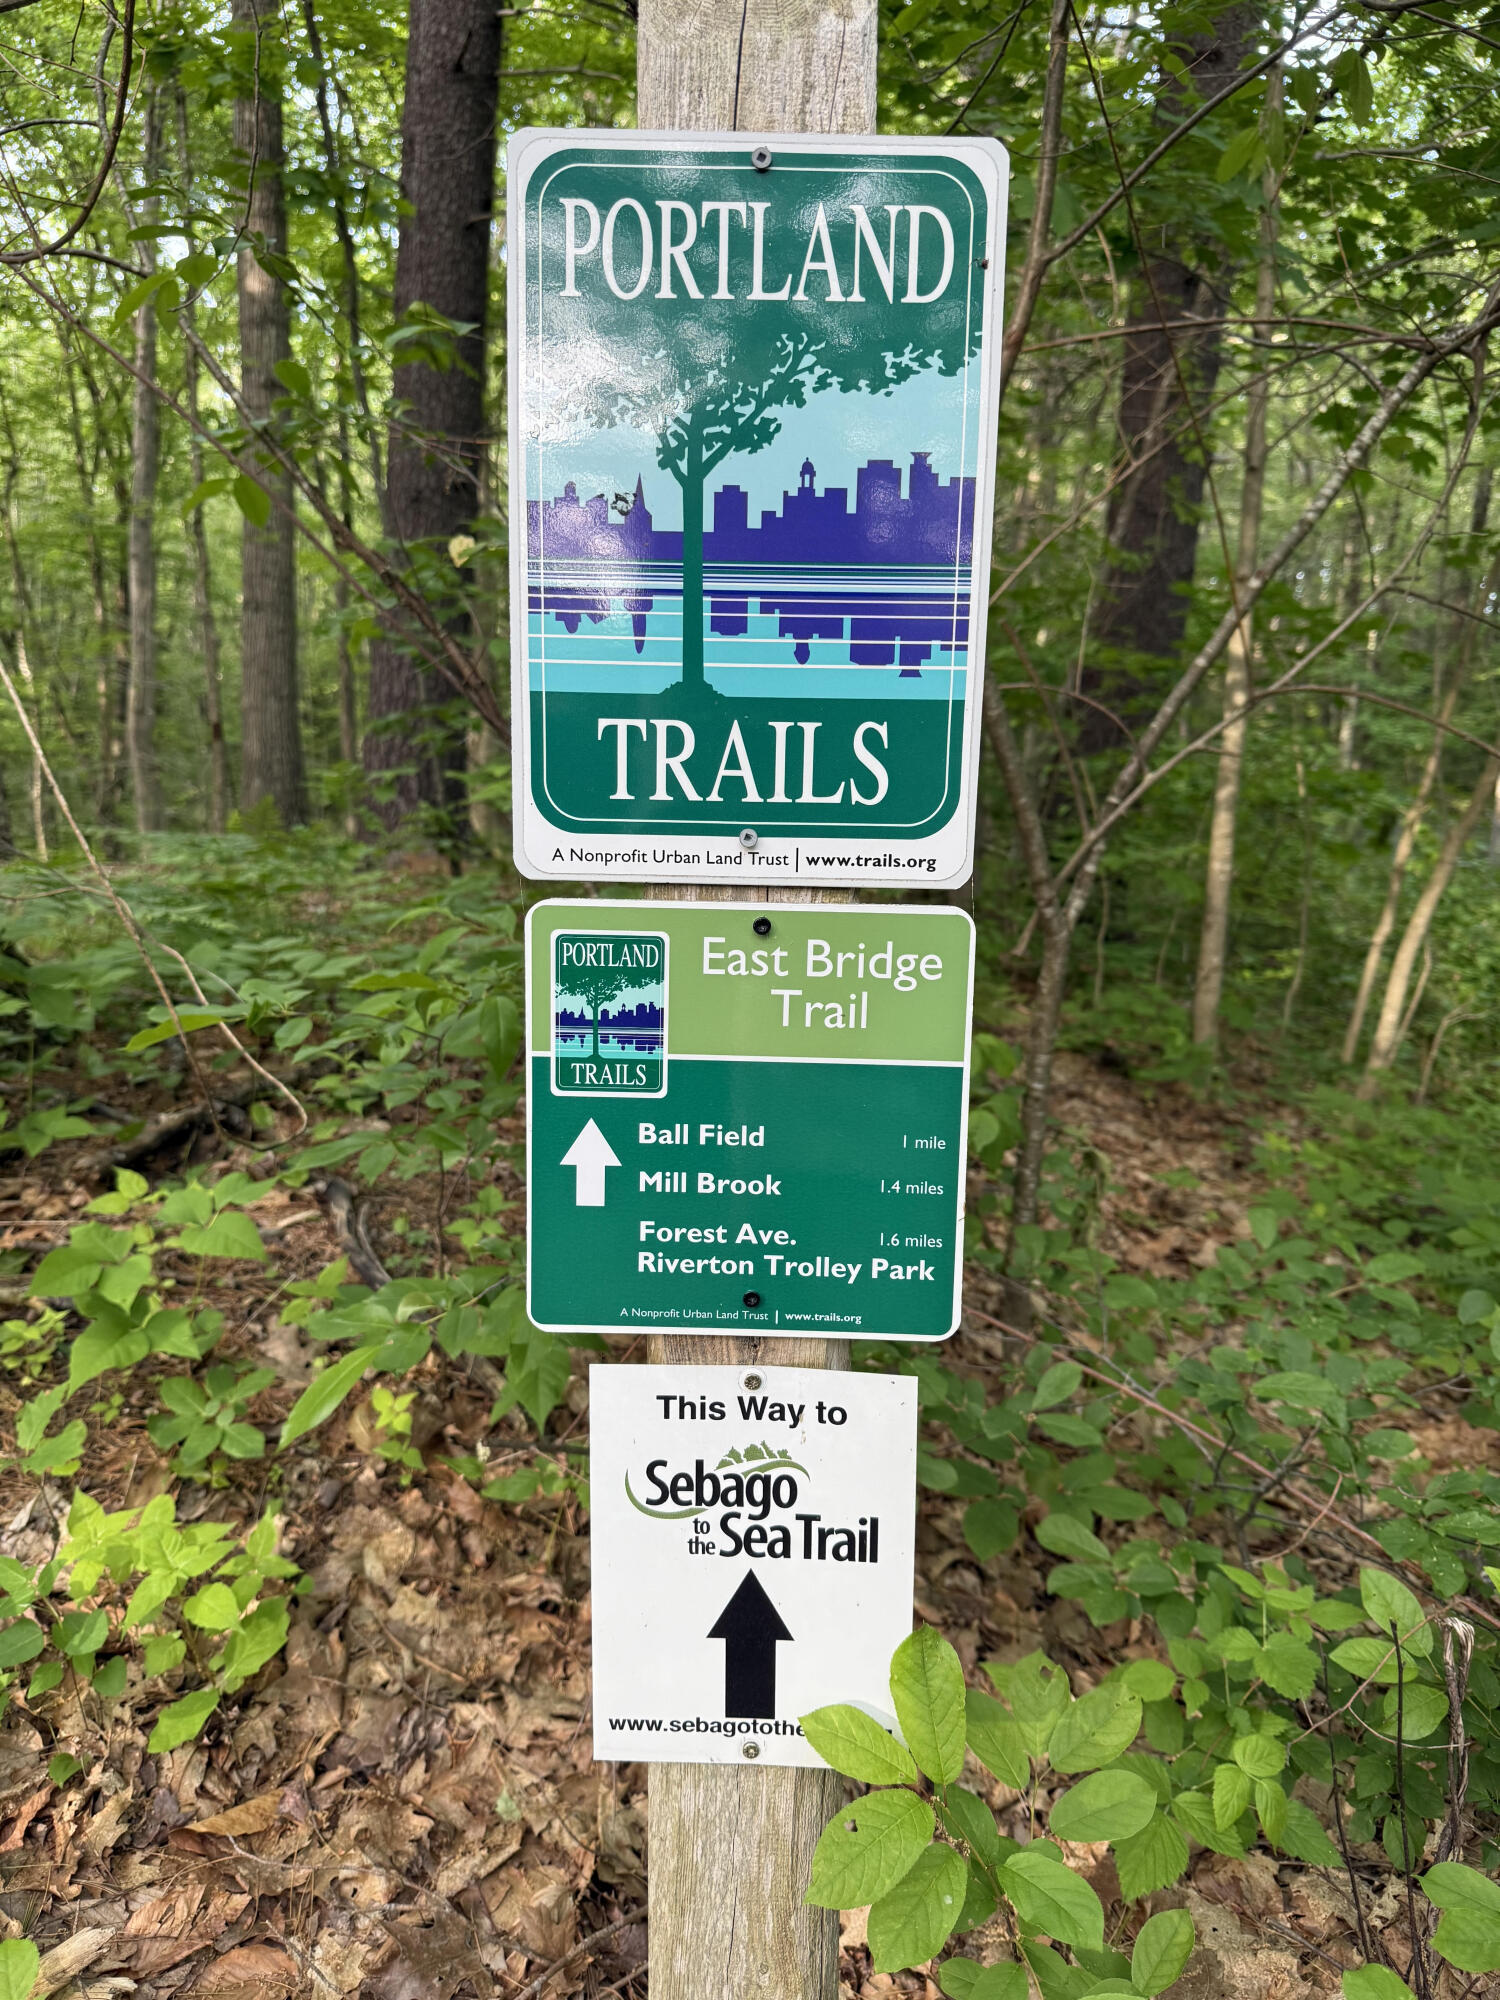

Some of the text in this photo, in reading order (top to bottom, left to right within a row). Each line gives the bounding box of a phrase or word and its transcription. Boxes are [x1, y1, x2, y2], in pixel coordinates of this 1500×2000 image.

[559, 197, 955, 304] PORTLAND
[597, 717, 889, 806] TRAILS
[552, 847, 937, 873] A Nonprofit Urban Land Trust www.trails.org
[562, 942, 659, 968] PORTLAND
[702, 936, 943, 992] East Bridge
[770, 988, 868, 1029] Trail
[570, 1062, 647, 1086] TRAILS
[638, 1122, 689, 1145] Ball
[699, 1124, 765, 1147] Field
[915, 1135, 946, 1150] mile
[639, 1170, 944, 1196] Mill Brook 1.4 miles
[639, 1220, 943, 1248] Forest Ave. 1.6 miles
[638, 1251, 935, 1285] Riverton Trolley Park
[620, 1307, 862, 1325] A Nonprofit Urban Land Trust www.trails.org
[656, 1395, 848, 1429] This Way to
[645, 1459, 798, 1520] Sebago
[692, 1518, 711, 1535] to
[719, 1511, 879, 1564] Sea Trail
[687, 1535, 716, 1555] the
[608, 1716, 893, 1737] www.sebagotothe
